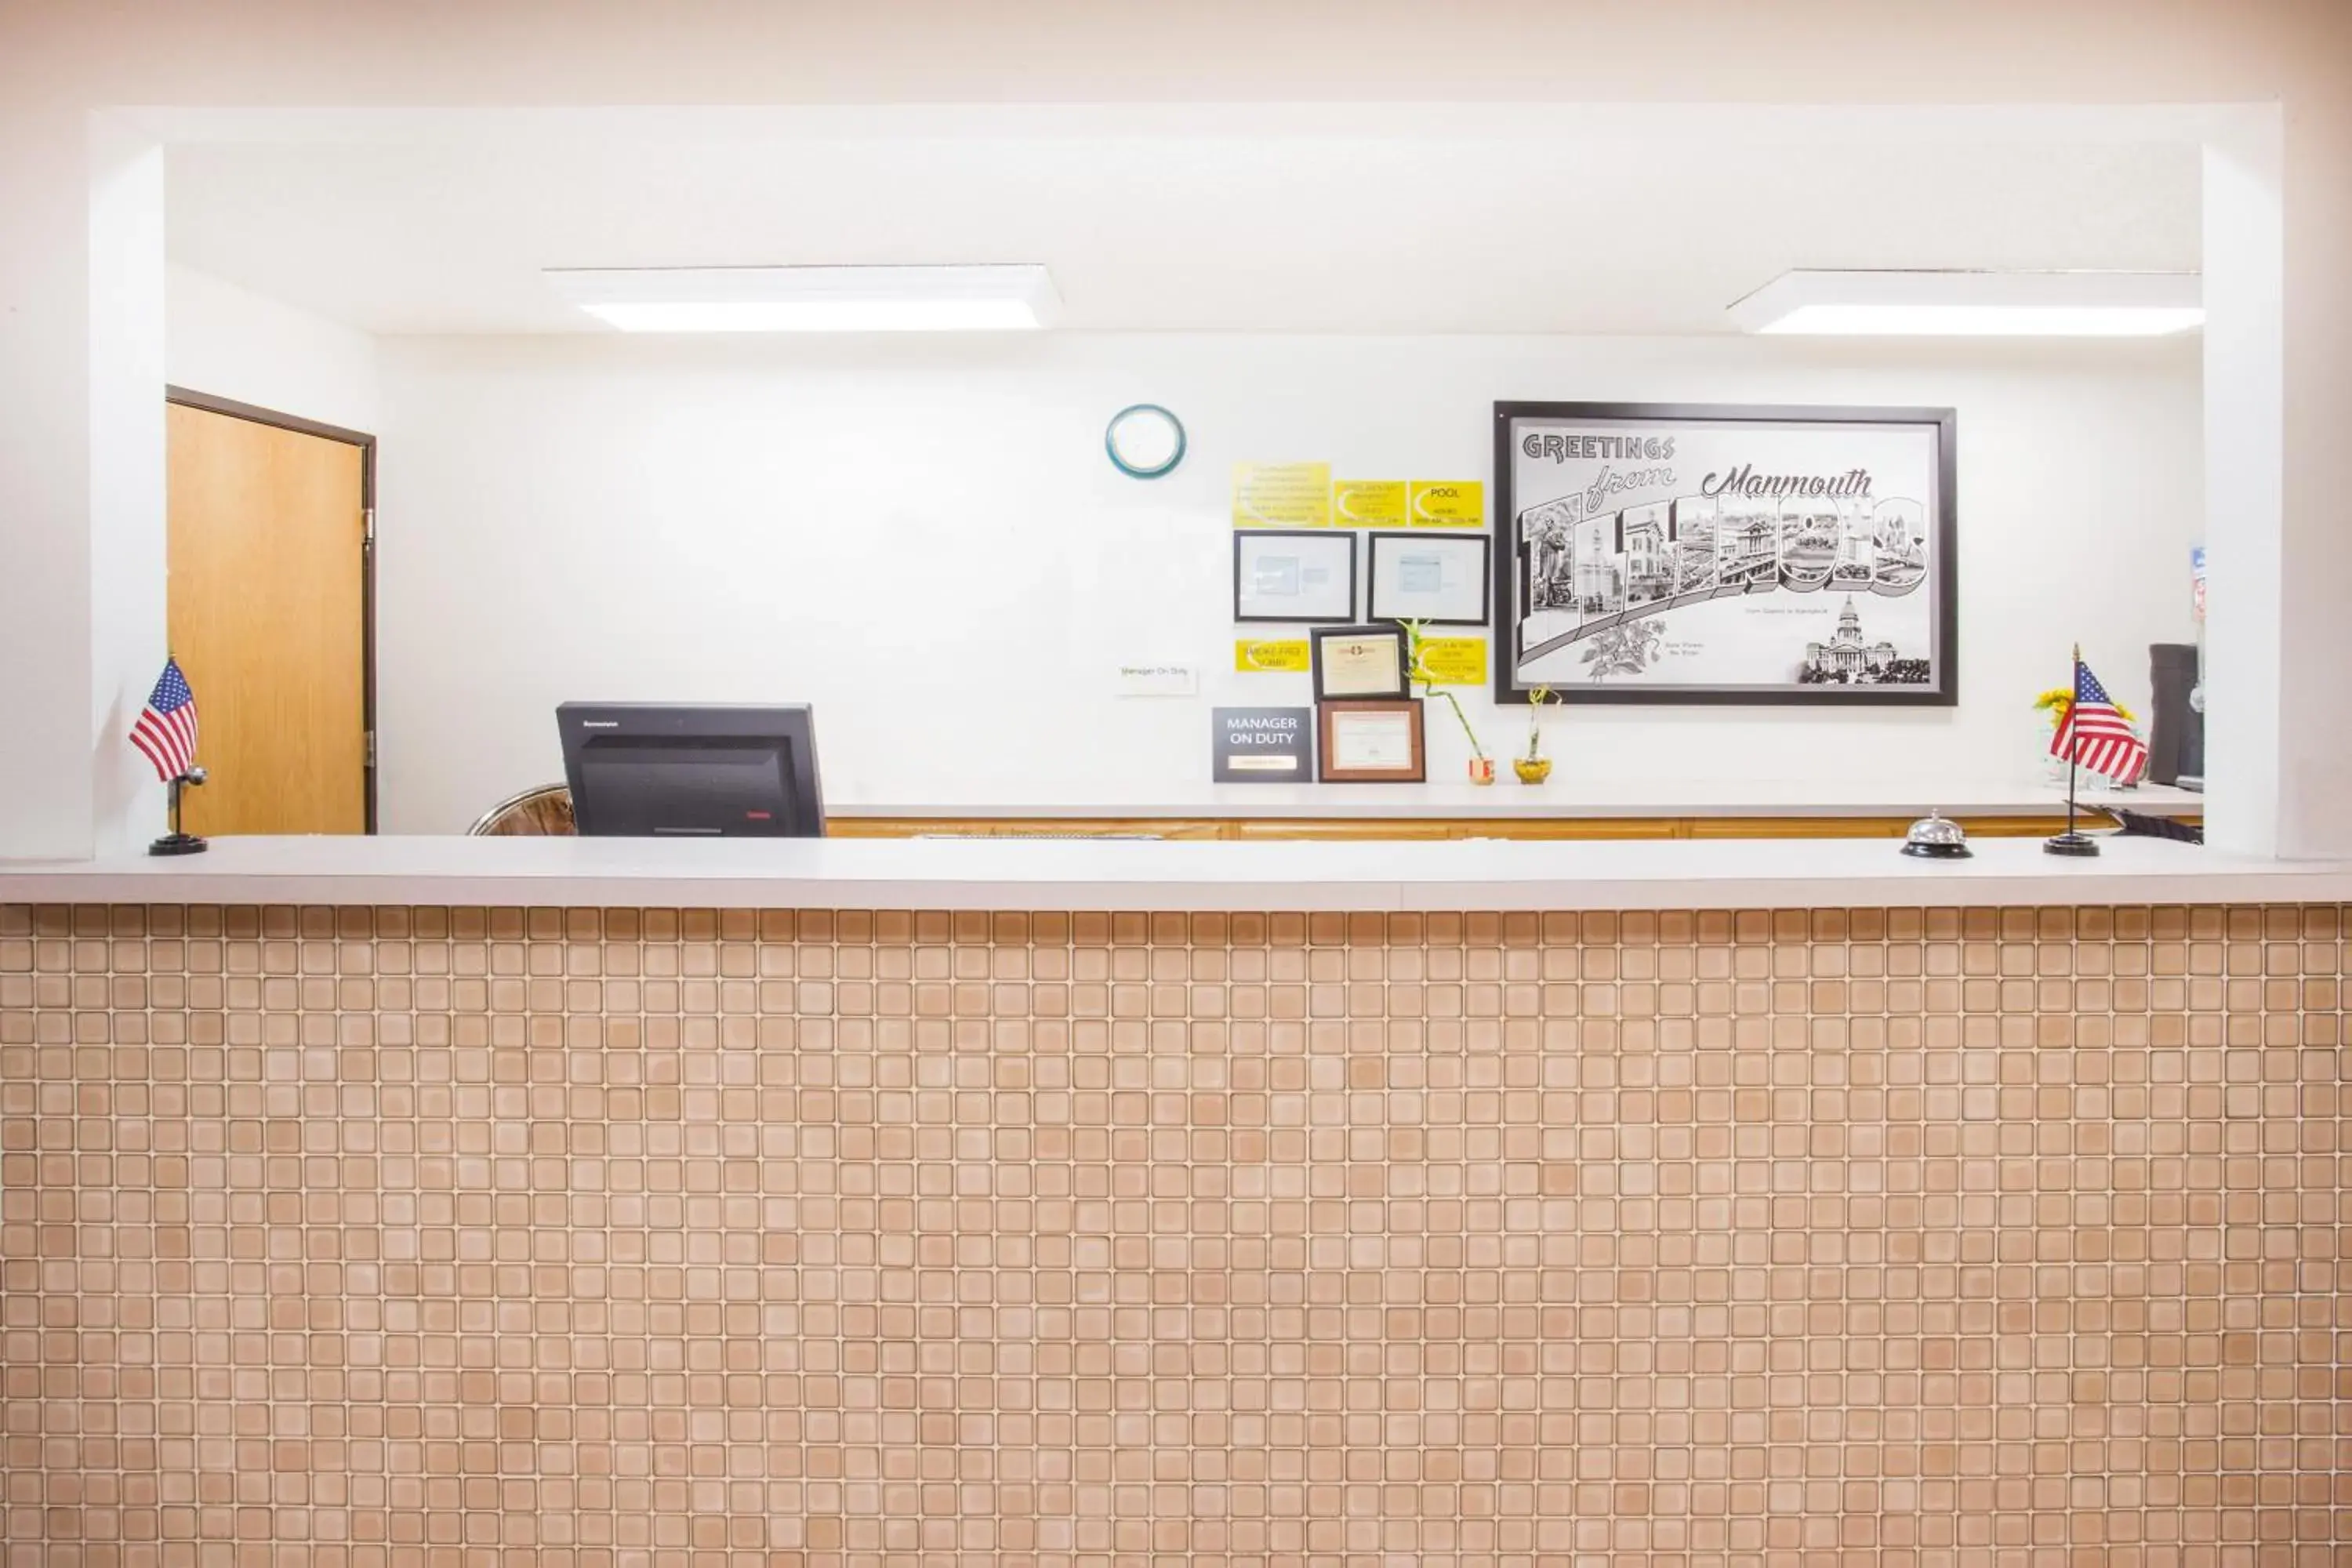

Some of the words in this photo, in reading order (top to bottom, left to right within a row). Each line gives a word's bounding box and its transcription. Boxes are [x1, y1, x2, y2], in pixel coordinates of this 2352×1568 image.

[1522, 434, 1676, 464] GREETINGS
[1431, 488, 1459, 499] POOL
[1587, 465, 1677, 514] from
[1227, 717, 1298, 729] MANAGER
[1230, 733, 1253, 745] ON
[1256, 733, 1294, 745] DUTY
